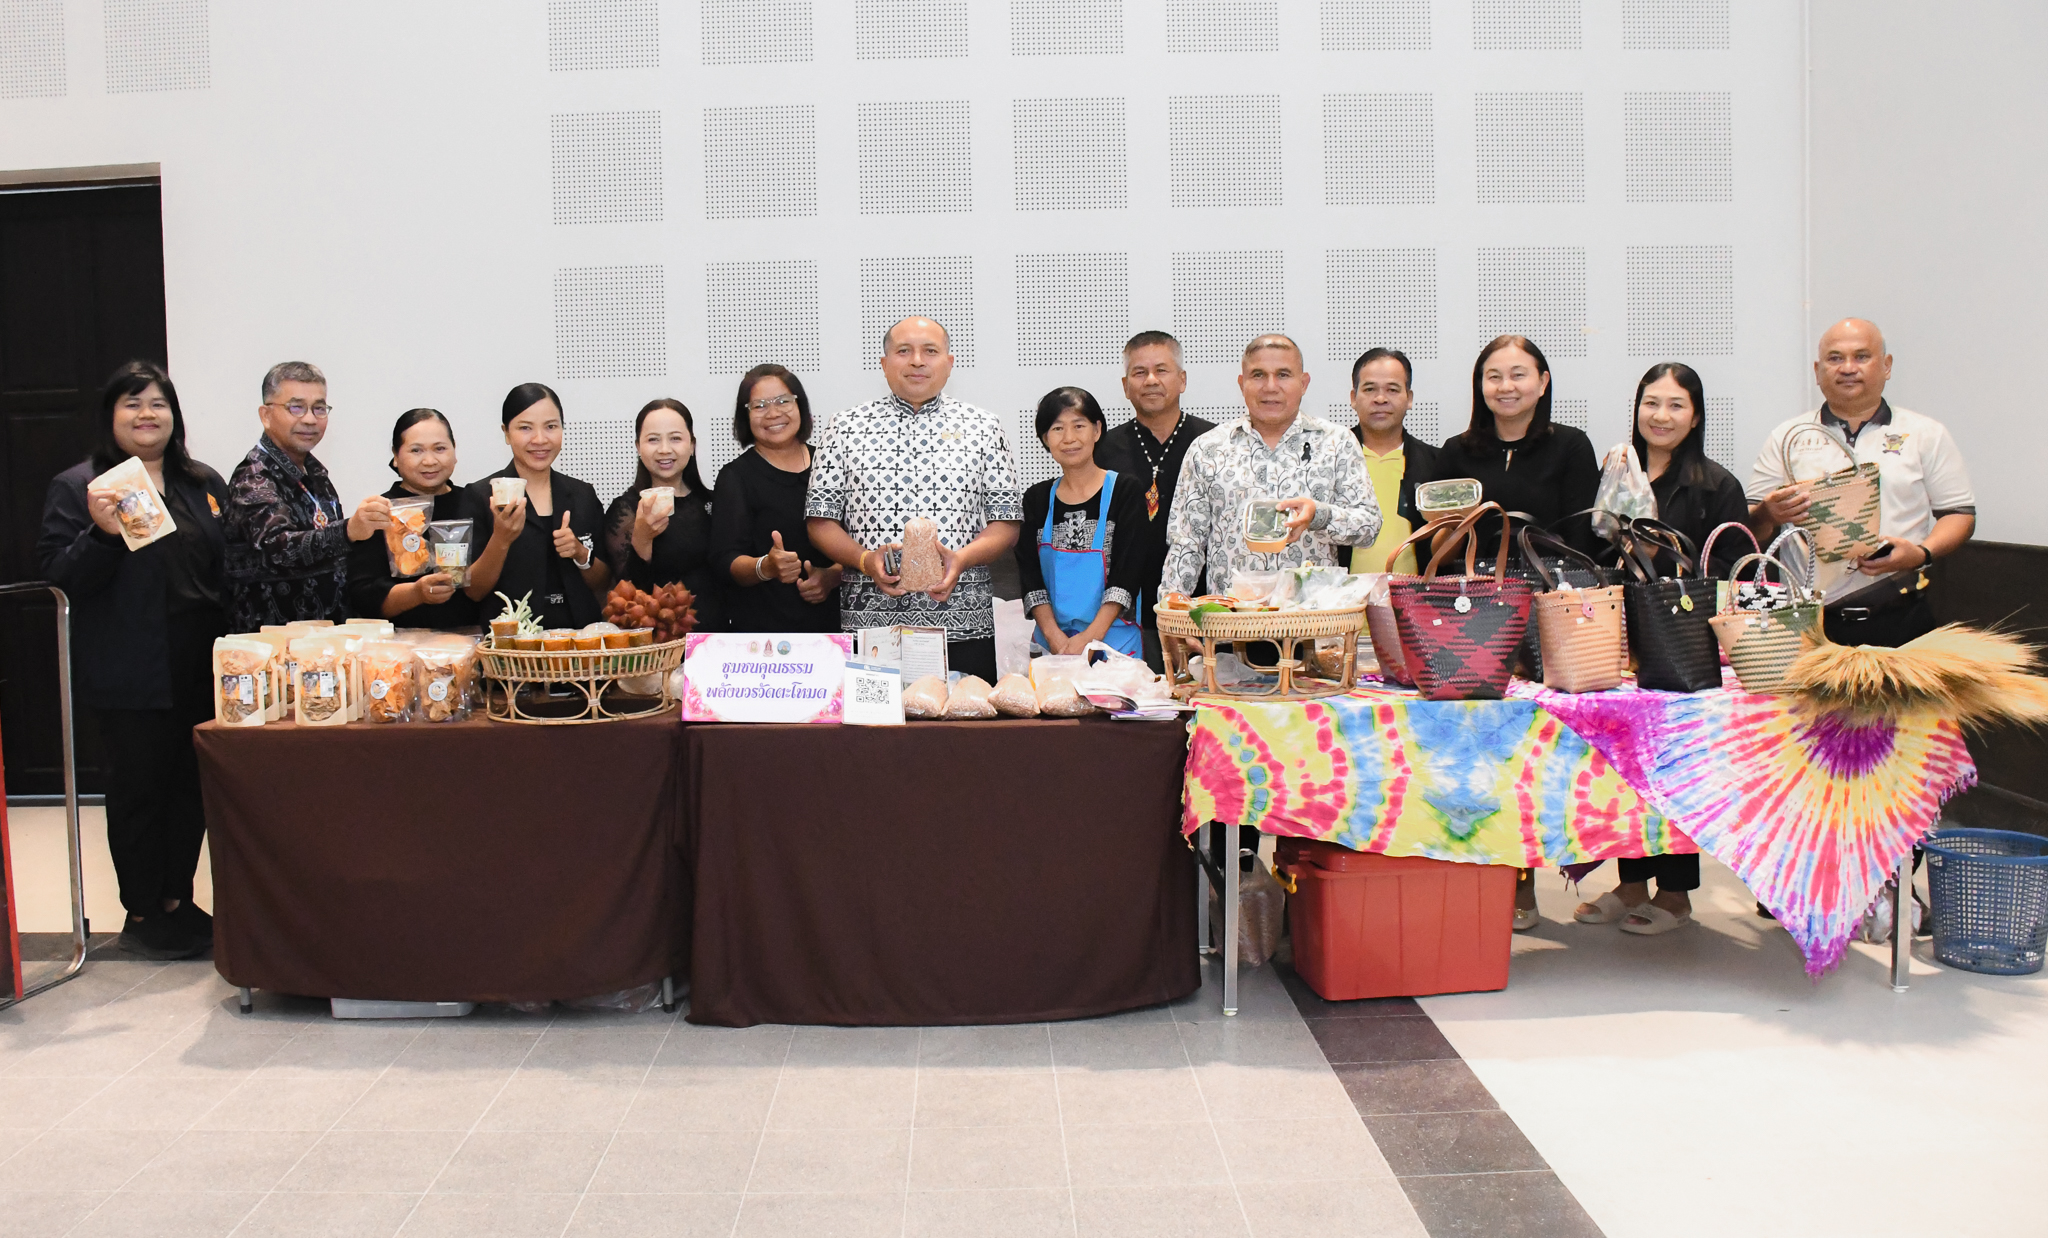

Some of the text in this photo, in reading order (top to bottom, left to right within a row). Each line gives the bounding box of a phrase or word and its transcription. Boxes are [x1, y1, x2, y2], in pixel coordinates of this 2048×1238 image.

[722, 662, 814, 680] ชุมชนคุณธรรม
[706, 681, 828, 699] พลังบวรวัดตะโหมด
